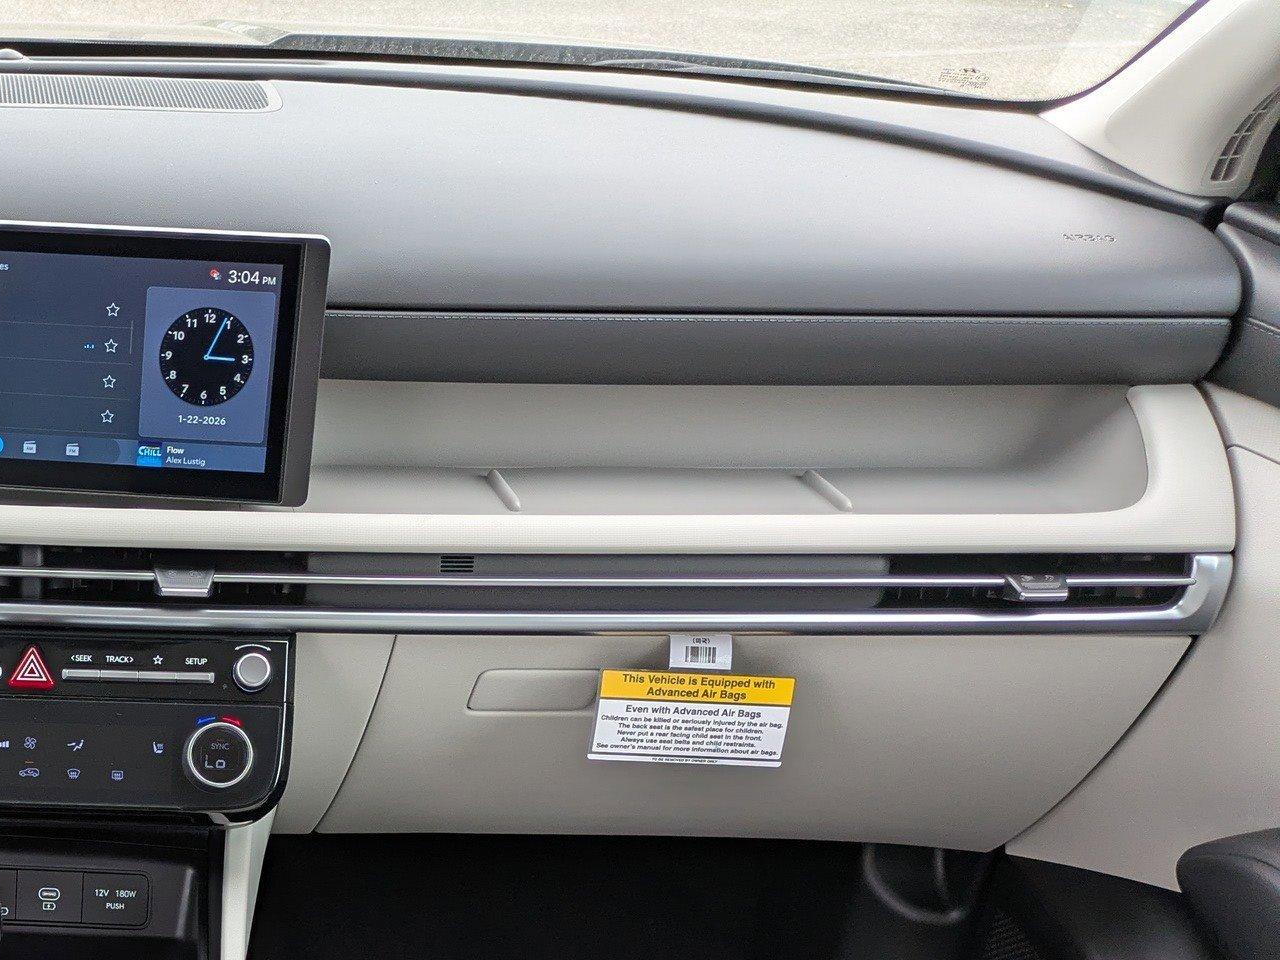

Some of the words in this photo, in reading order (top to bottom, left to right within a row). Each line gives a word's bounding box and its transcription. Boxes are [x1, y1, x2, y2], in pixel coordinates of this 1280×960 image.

[228, 270, 260, 285] 3:04
[262, 277, 276, 286] PM
[187, 318, 198, 328] 11
[204, 314, 216, 324] 12
[173, 331, 186, 341] 10
[237, 334, 245, 344] 2
[165, 351, 172, 360] 9
[242, 355, 248, 364] 3
[170, 370, 176, 380] 8
[234, 374, 241, 382] 4
[182, 384, 189, 394] 7
[220, 386, 226, 396] 5
[200, 390, 207, 400] 6
[178, 415, 226, 426] 1-22-2026
[138, 446, 162, 457] CHILL
[166, 456, 181, 464] Alex
[183, 458, 206, 466] Lustig
[185, 658, 208, 666] SETUP
[622, 674, 644, 684] This
[648, 675, 686, 686] Vehicle
[688, 676, 697, 686] is
[700, 678, 750, 688] Equipped
[753, 680, 776, 689] with
[646, 686, 699, 698] Advanced
[702, 689, 716, 698] Air
[720, 690, 746, 701] Bags
[626, 705, 648, 713] Even
[652, 706, 670, 714] with
[672, 706, 720, 716] Advanced
[738, 710, 762, 720] Bags
[210, 742, 230, 750] SYNC
[94, 888, 110, 898] 12V
[115, 889, 137, 898] 180W
[106, 902, 124, 910] PUSH
